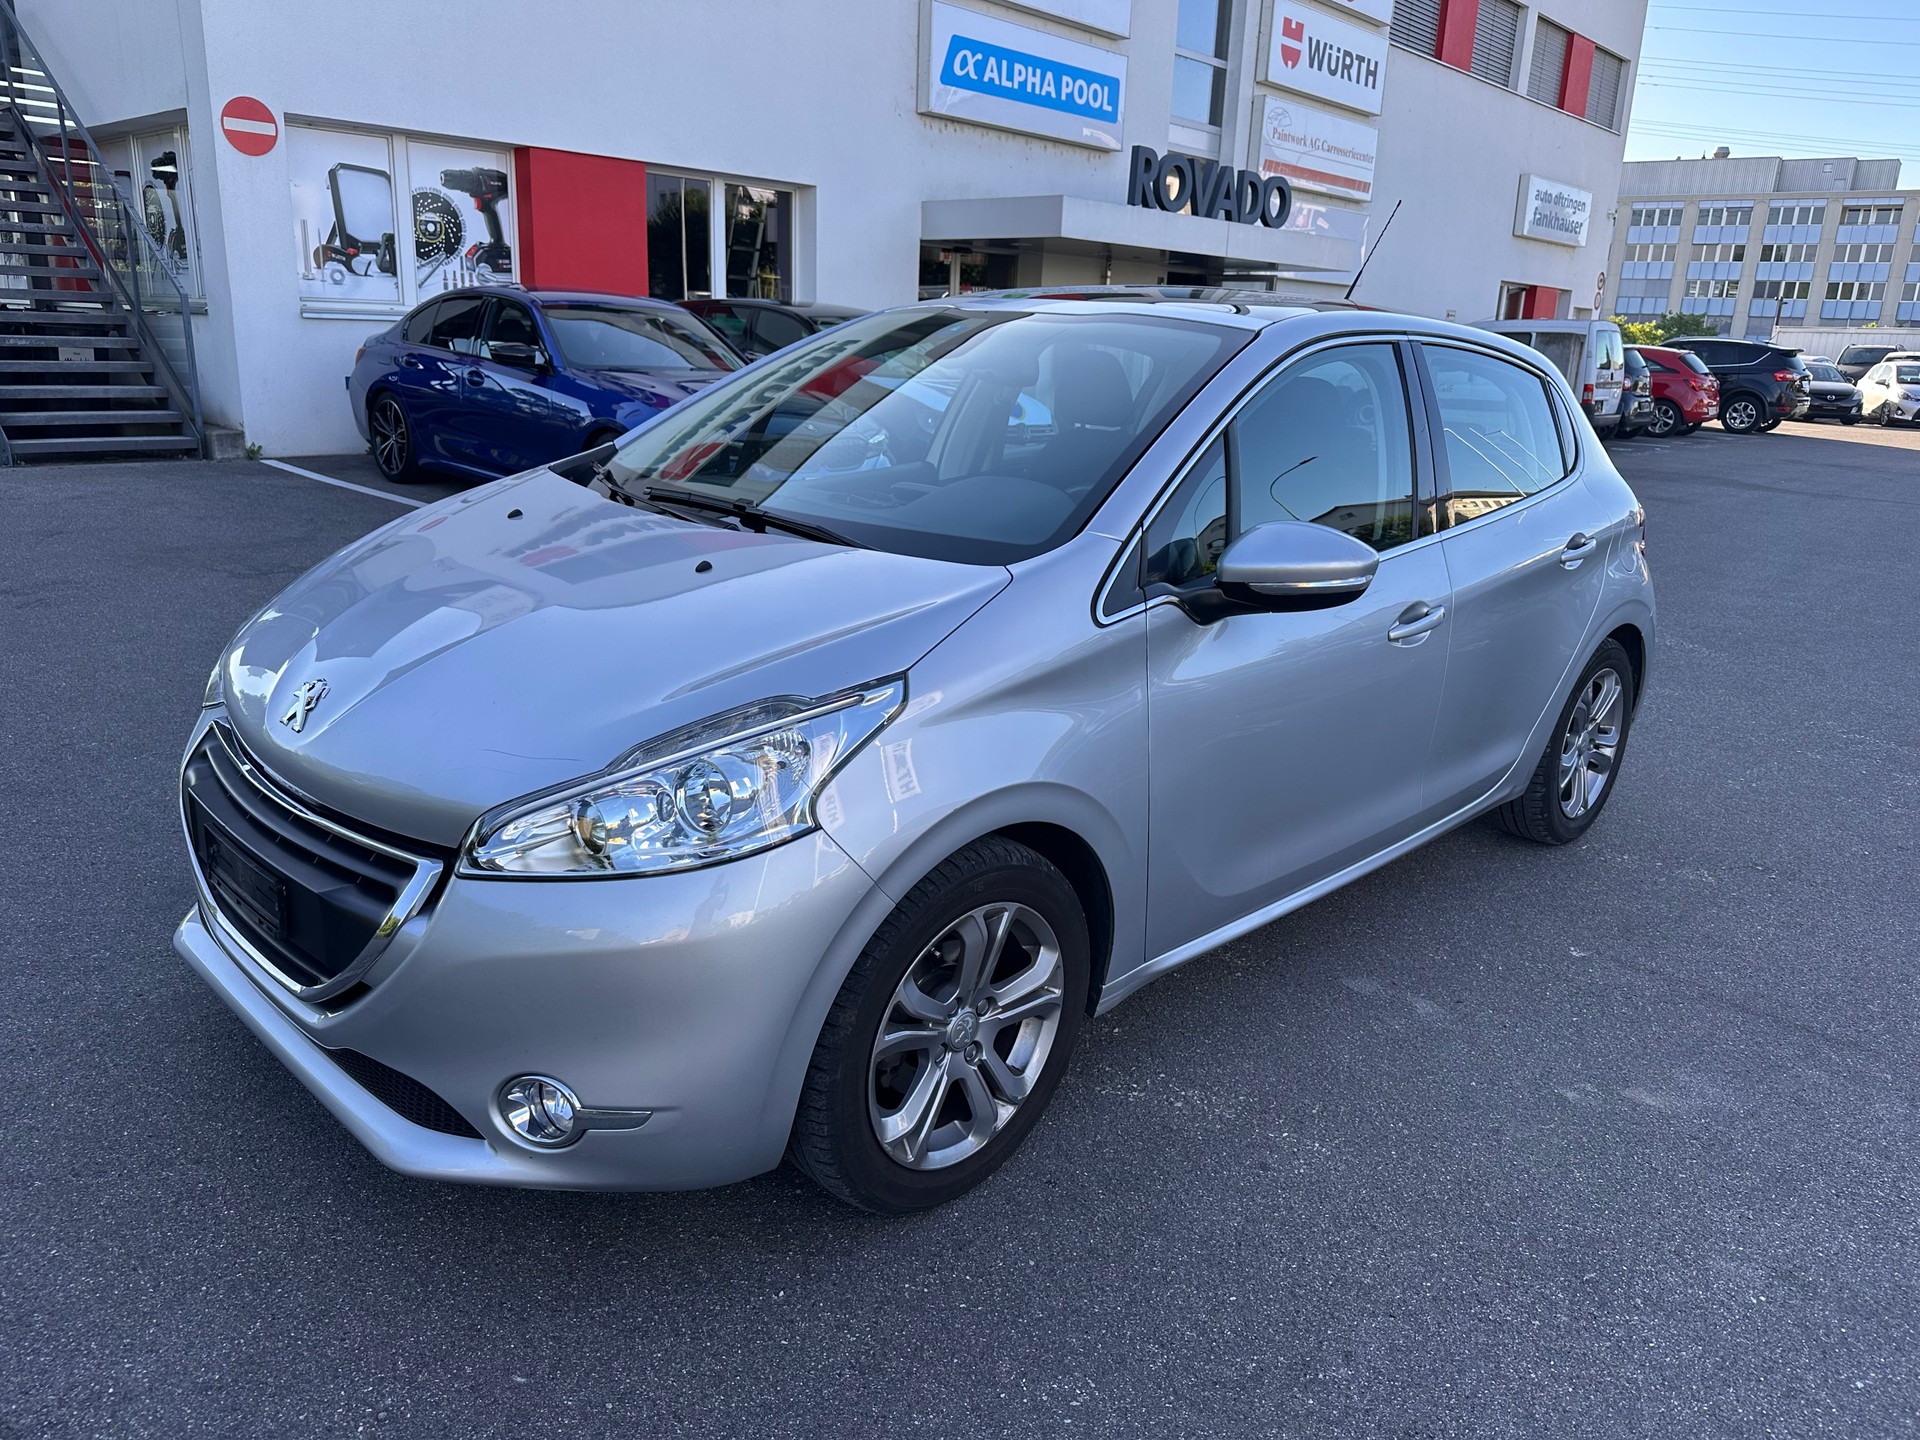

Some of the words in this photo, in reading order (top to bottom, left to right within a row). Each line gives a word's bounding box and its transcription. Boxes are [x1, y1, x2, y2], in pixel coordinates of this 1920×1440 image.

[983, 56, 1056, 98] ALPHA
[1060, 75, 1113, 112] POOL
[1308, 36, 1379, 90] WÜRTH
[1272, 127, 1308, 147] Paintwork
[1309, 136, 1321, 151] AG
[1321, 140, 1375, 164] Carrosseriecenter
[1127, 145, 1292, 229] ROVADO
[1534, 189, 1553, 204] auto
[1532, 206, 1583, 235] fankhauser
